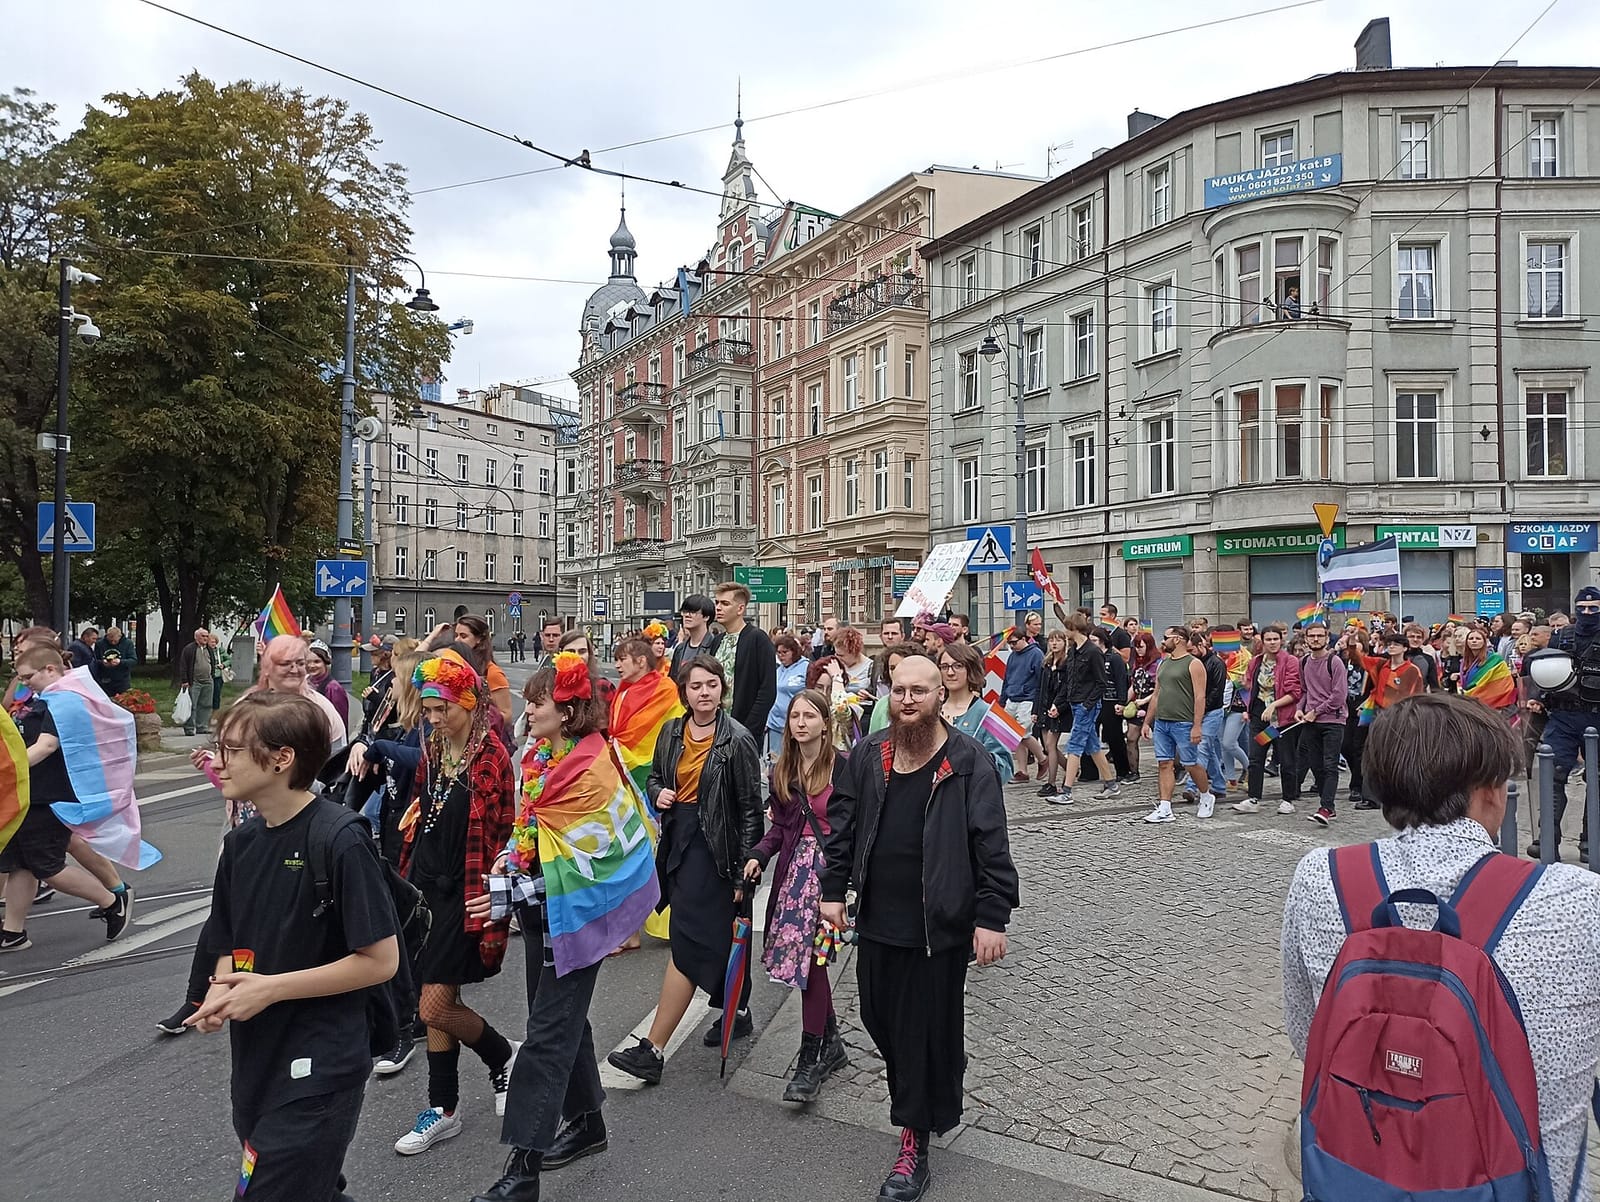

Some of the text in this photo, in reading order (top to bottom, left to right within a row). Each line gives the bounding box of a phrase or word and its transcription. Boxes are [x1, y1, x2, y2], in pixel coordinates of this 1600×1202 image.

[1211, 157, 1332, 188] NAUKA JAZDY kat.B
[1229, 171, 1314, 193] tel. 0601 822 350
[1513, 524, 1591, 533] SZKOŁA JAZDY
[1130, 541, 1181, 555] CENTRUM
[1523, 573, 1544, 588] 33
